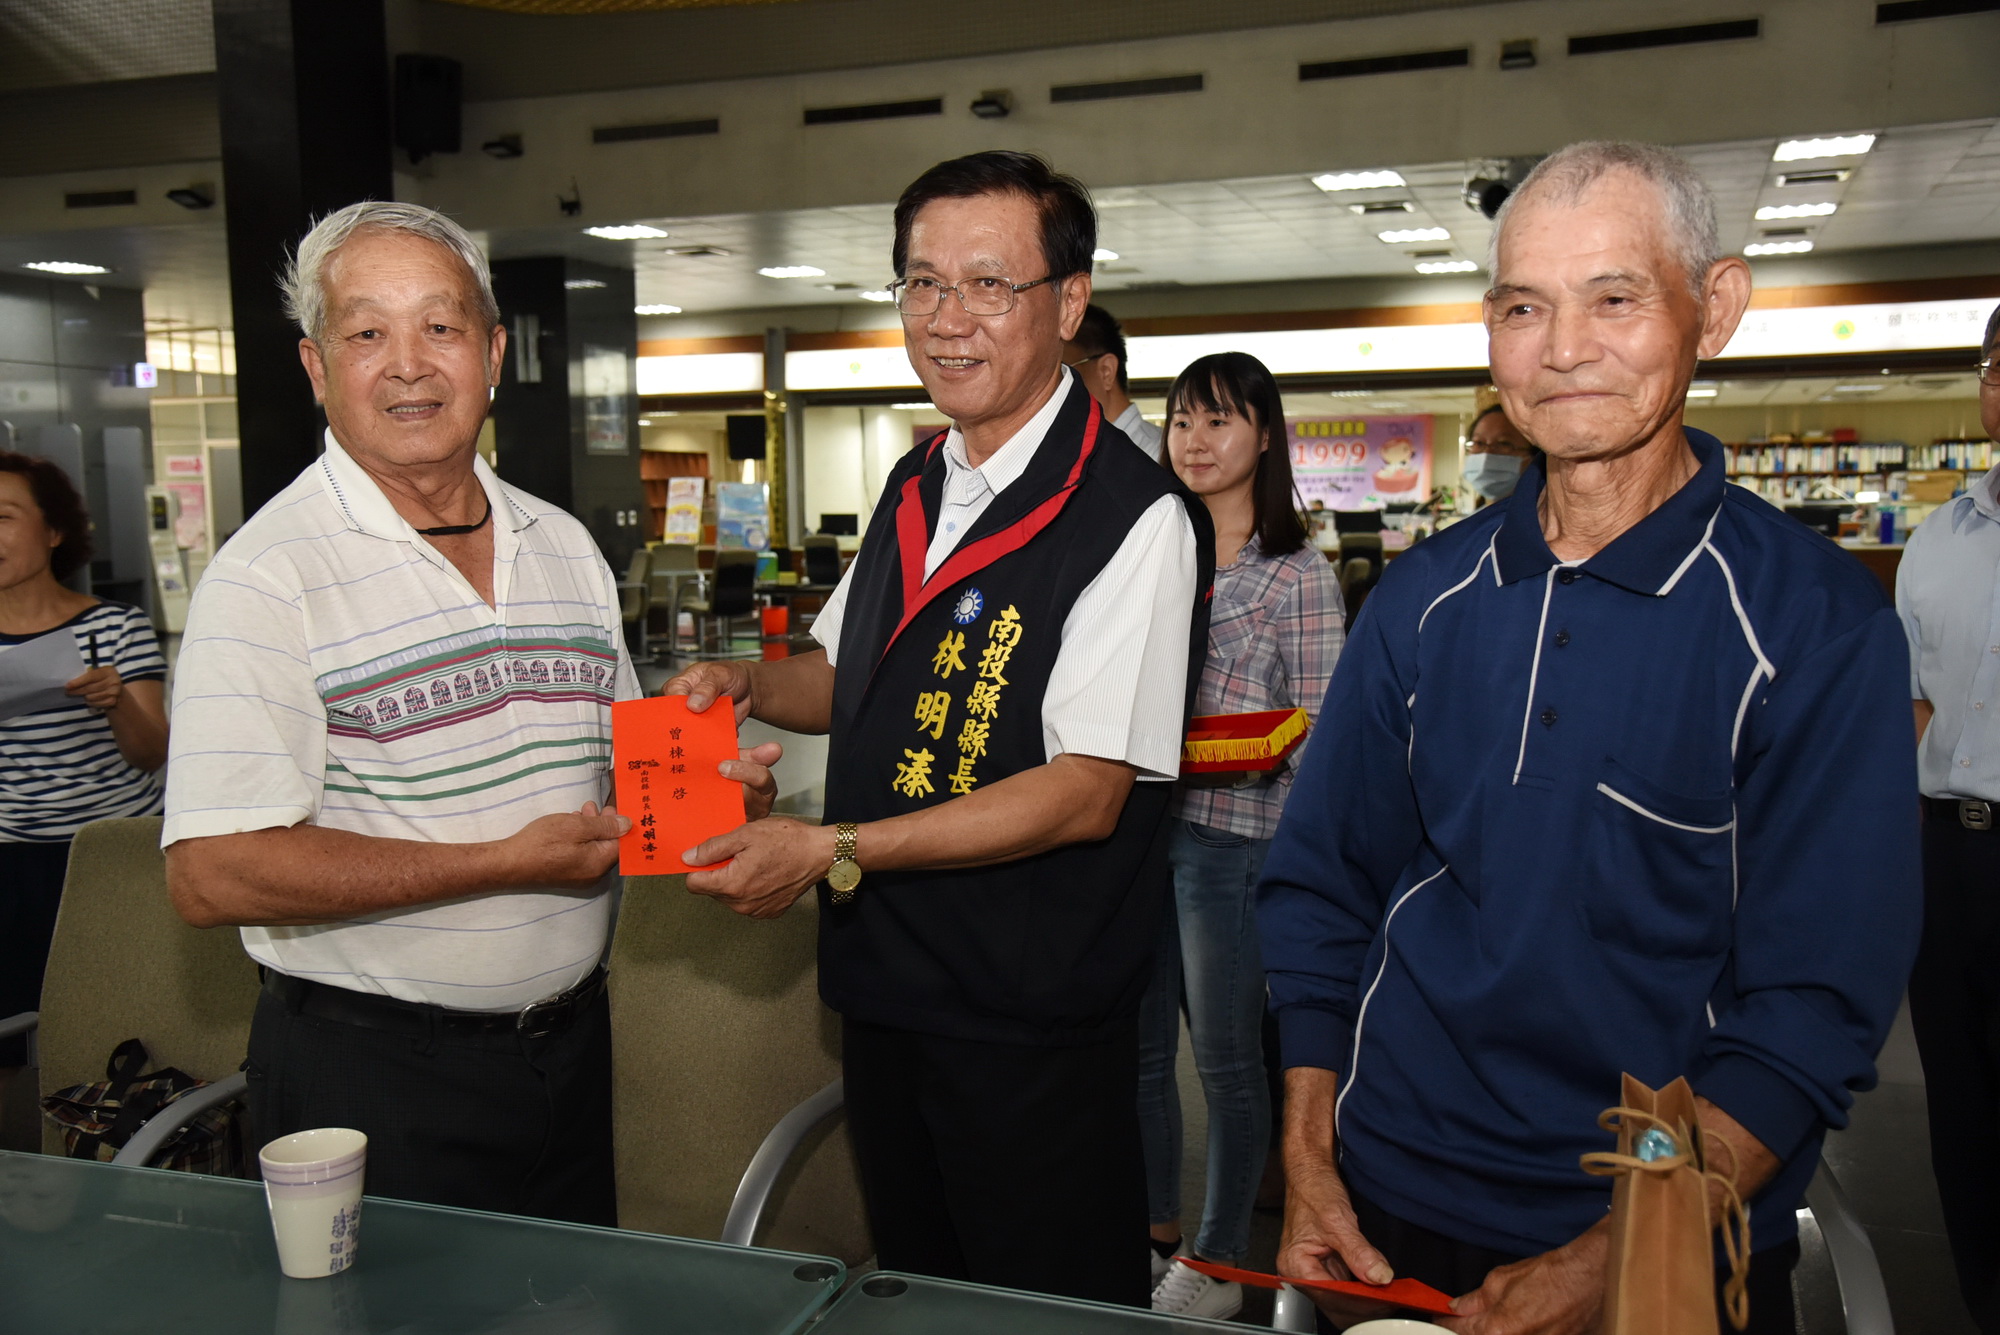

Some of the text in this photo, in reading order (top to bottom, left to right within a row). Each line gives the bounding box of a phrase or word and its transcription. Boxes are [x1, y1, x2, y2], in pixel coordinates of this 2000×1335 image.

[1295, 442, 1367, 465] 1999
[892, 629, 967, 798] 林明溱
[948, 604, 1023, 794] 南投縣縣長
